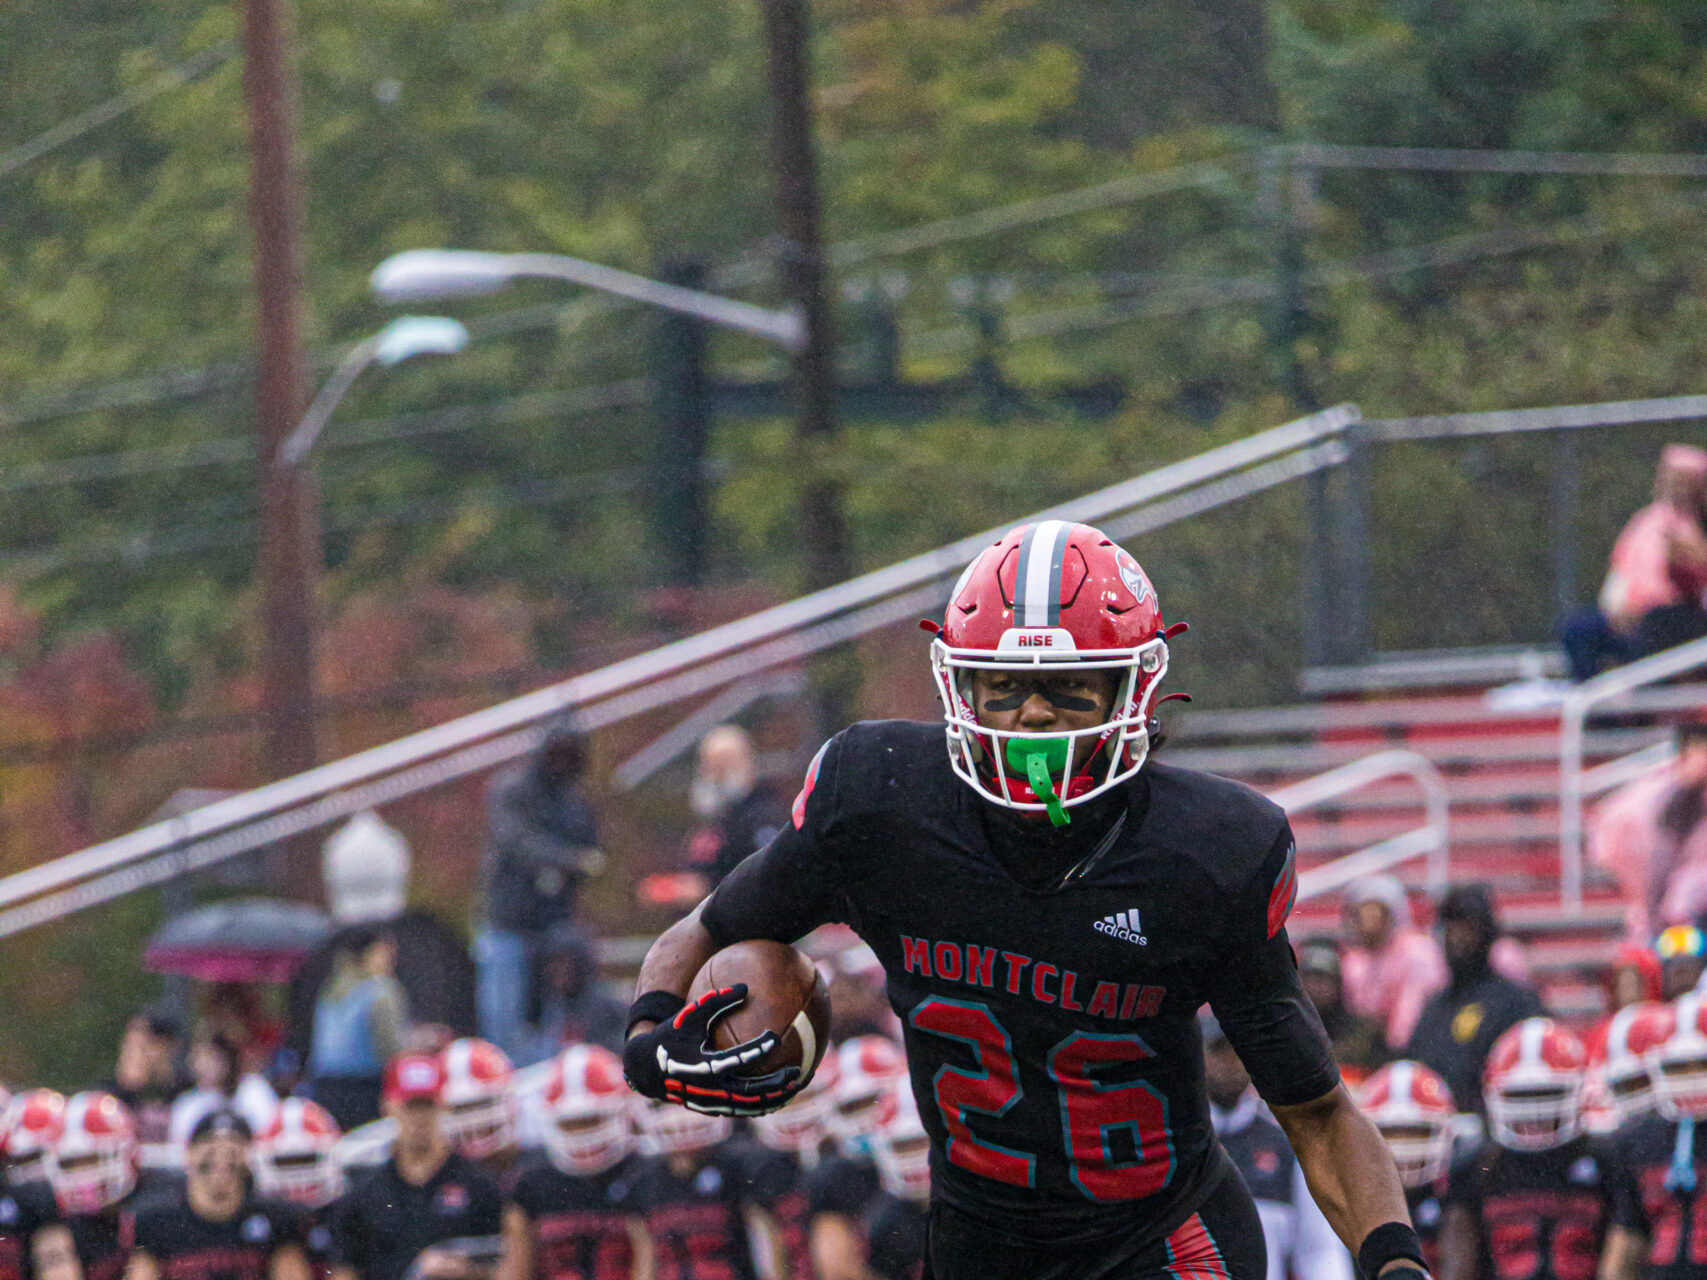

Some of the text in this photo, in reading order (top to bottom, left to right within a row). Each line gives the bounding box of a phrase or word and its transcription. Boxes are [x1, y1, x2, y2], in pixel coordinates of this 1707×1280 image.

[1018, 635, 1053, 647] RISE
[1093, 920, 1148, 946] adidas
[901, 934, 1167, 1020] MONTCLAIR
[907, 993, 1178, 1201] 26
